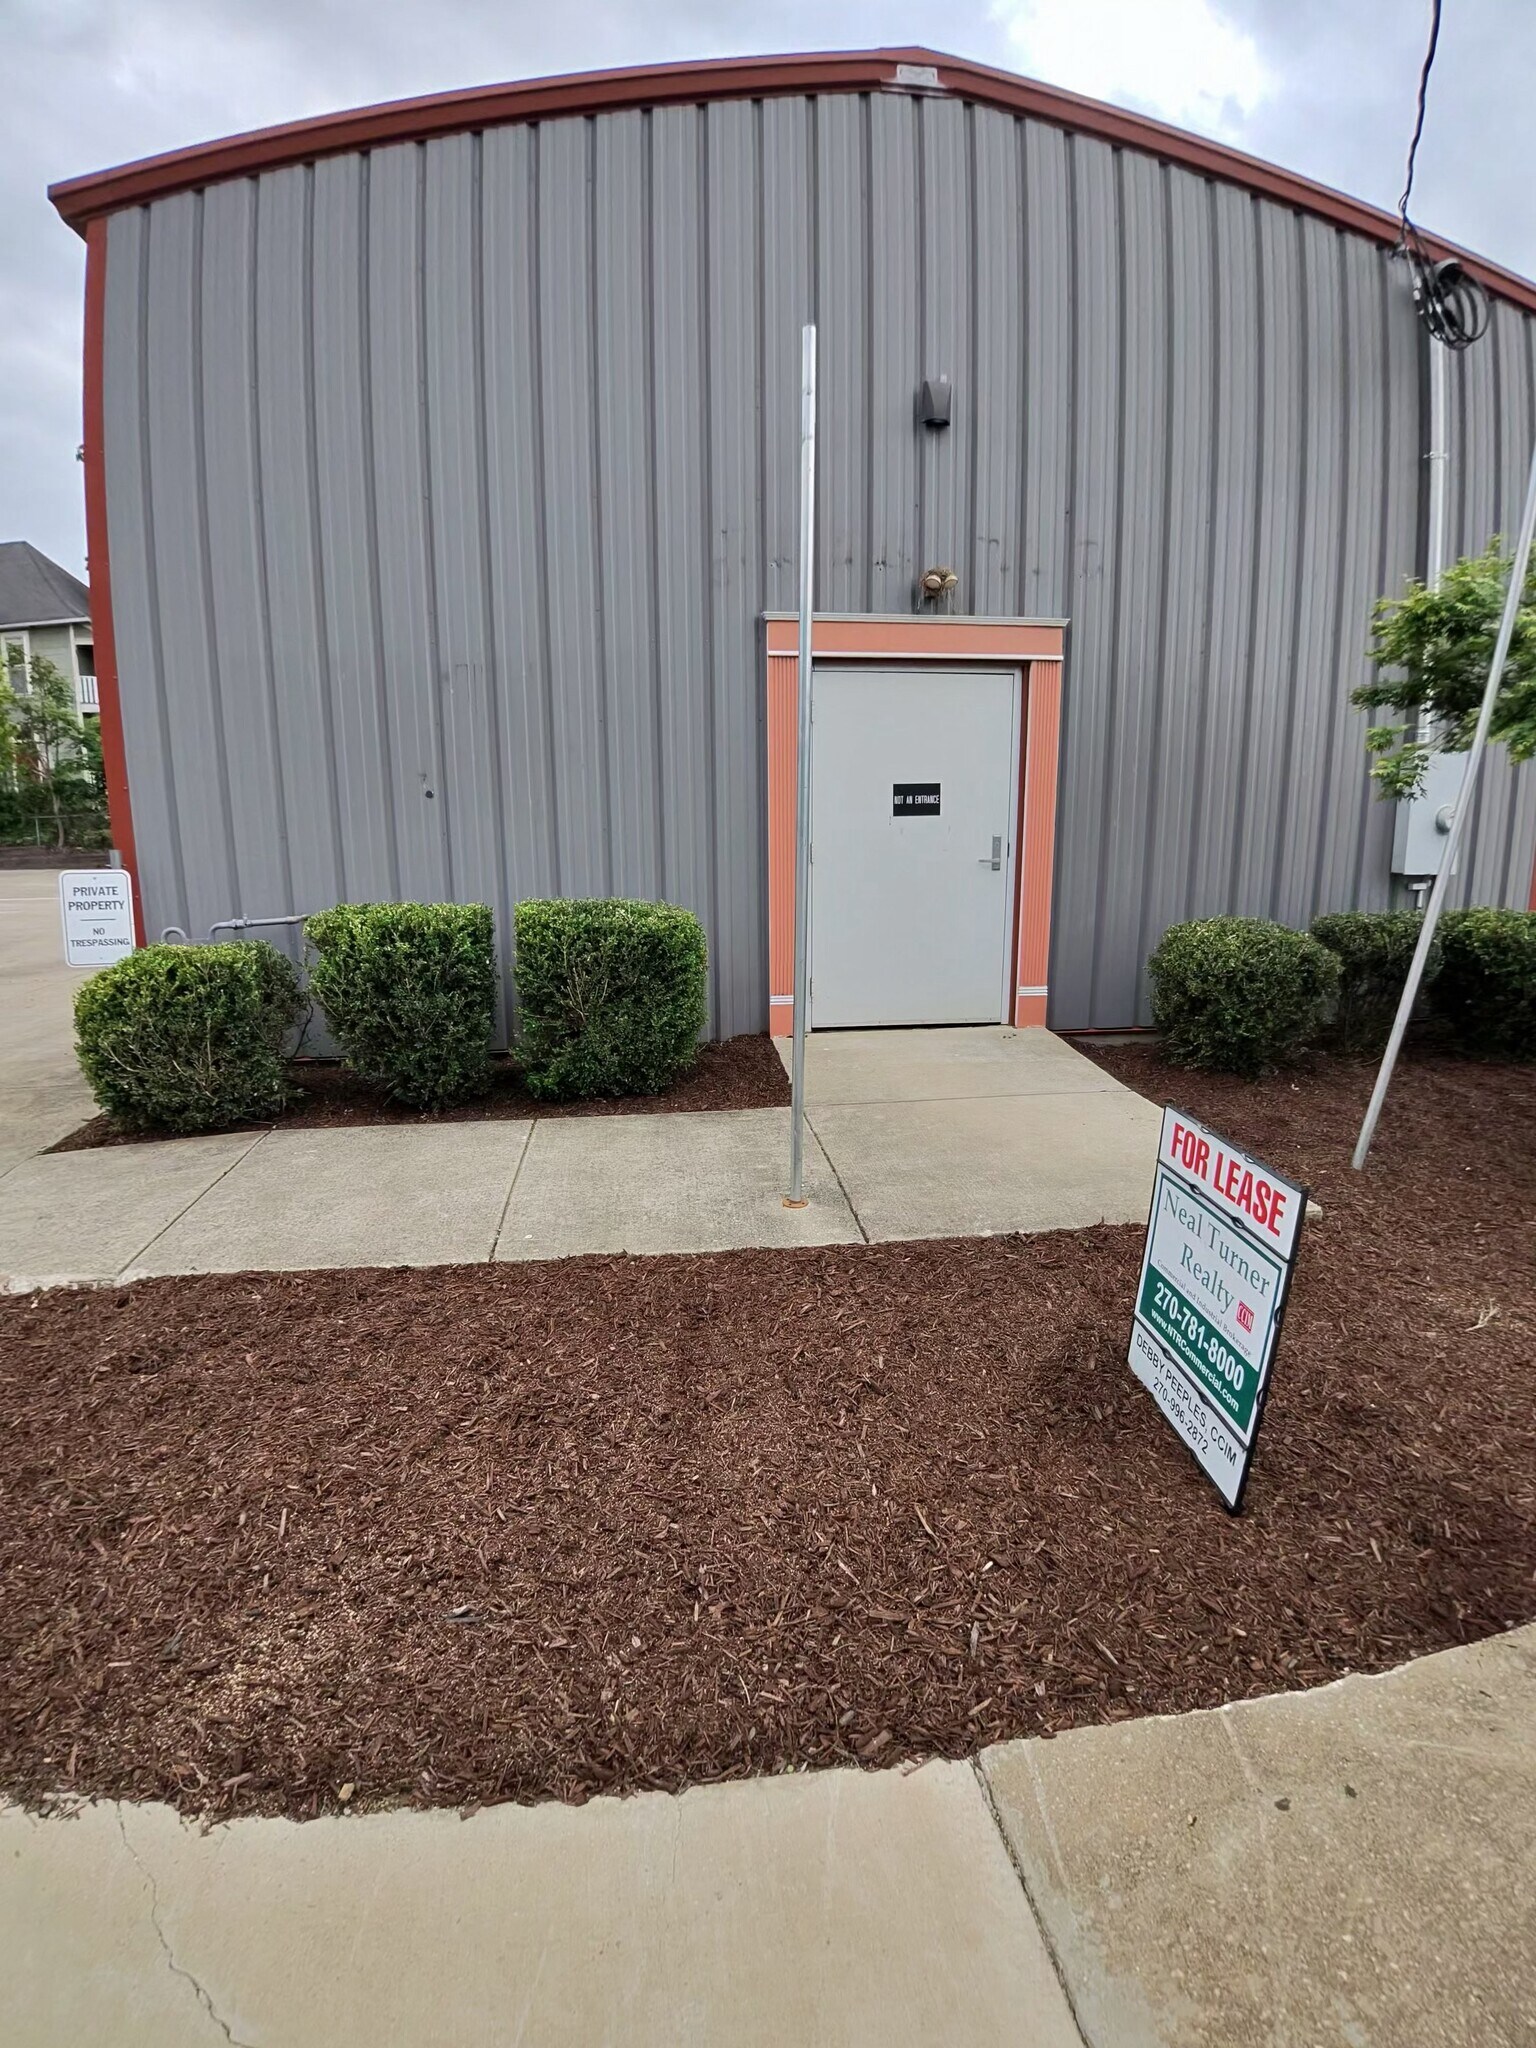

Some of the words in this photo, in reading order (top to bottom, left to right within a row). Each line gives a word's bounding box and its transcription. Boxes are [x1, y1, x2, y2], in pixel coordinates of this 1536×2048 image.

[894, 795, 904, 804] NOT
[906, 795, 913, 804] AN
[914, 794, 940, 804] ENTRANCE
[68, 900, 125, 911] PROPERTY
[73, 886, 119, 897] PRIVATE
[70, 938, 130, 948] TRESPASSING
[93, 927, 105, 936] NO
[1170, 1122, 1210, 1181] FOR
[1213, 1151, 1287, 1237] LEASE
[1163, 1187, 1203, 1238] Neal
[1207, 1222, 1270, 1297] Turner
[1180, 1242, 1235, 1314] Realty
[1157, 1259, 1186, 1293] Commercial
[1186, 1287, 1197, 1301] and
[1196, 1298, 1222, 1328] Industrial
[1151, 1309, 1239, 1412] www.NTRCommercial.com
[1154, 1281, 1245, 1391] 270-781-8000
[1136, 1333, 1165, 1374] DEBBY
[1165, 1369, 1207, 1433] PEEPLES,
[1211, 1426, 1237, 1466] CCIM
[1153, 1376, 1209, 1454] 270-996-2872
